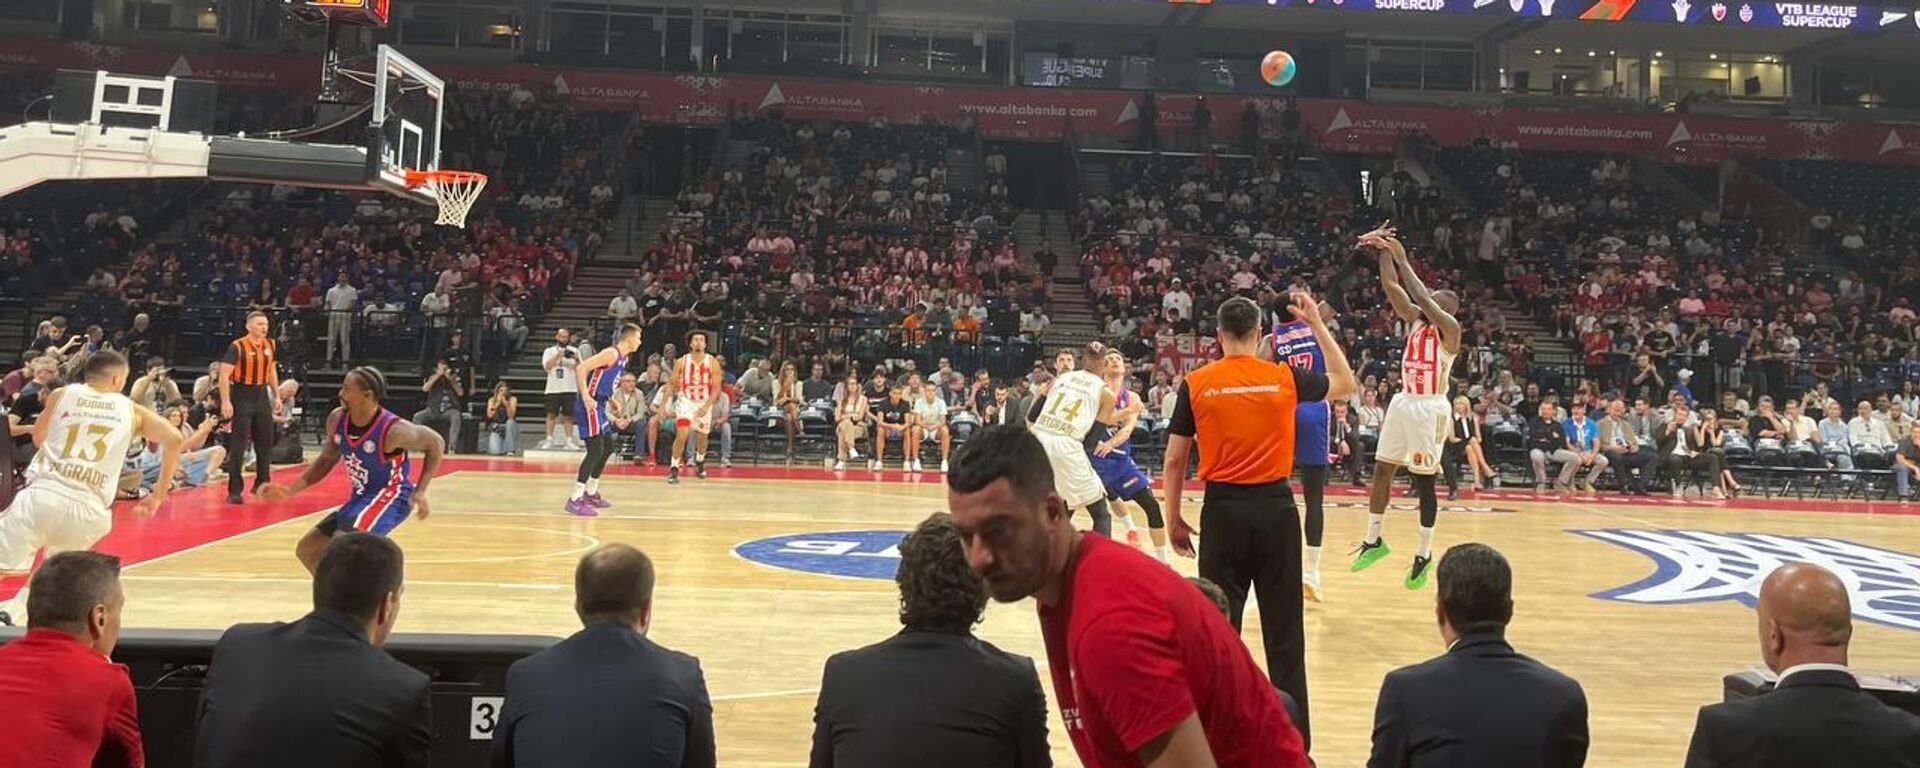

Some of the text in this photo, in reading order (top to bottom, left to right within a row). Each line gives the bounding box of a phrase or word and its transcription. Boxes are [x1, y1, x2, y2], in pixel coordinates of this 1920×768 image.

[1375, 0, 1444, 10] SUPERCUP
[1775, 3, 1857, 17] VTB LEAGUE
[1782, 15, 1851, 28] SUPERCUP
[787, 95, 862, 107] ALTABANKA
[1354, 119, 1427, 131] ALTABANKA
[1517, 124, 1653, 139] www.altabanka.com
[1693, 132, 1766, 144] ALTABANKA
[1048, 394, 1083, 422] 14
[59, 424, 115, 462] 13
[475, 703, 495, 734] 3
